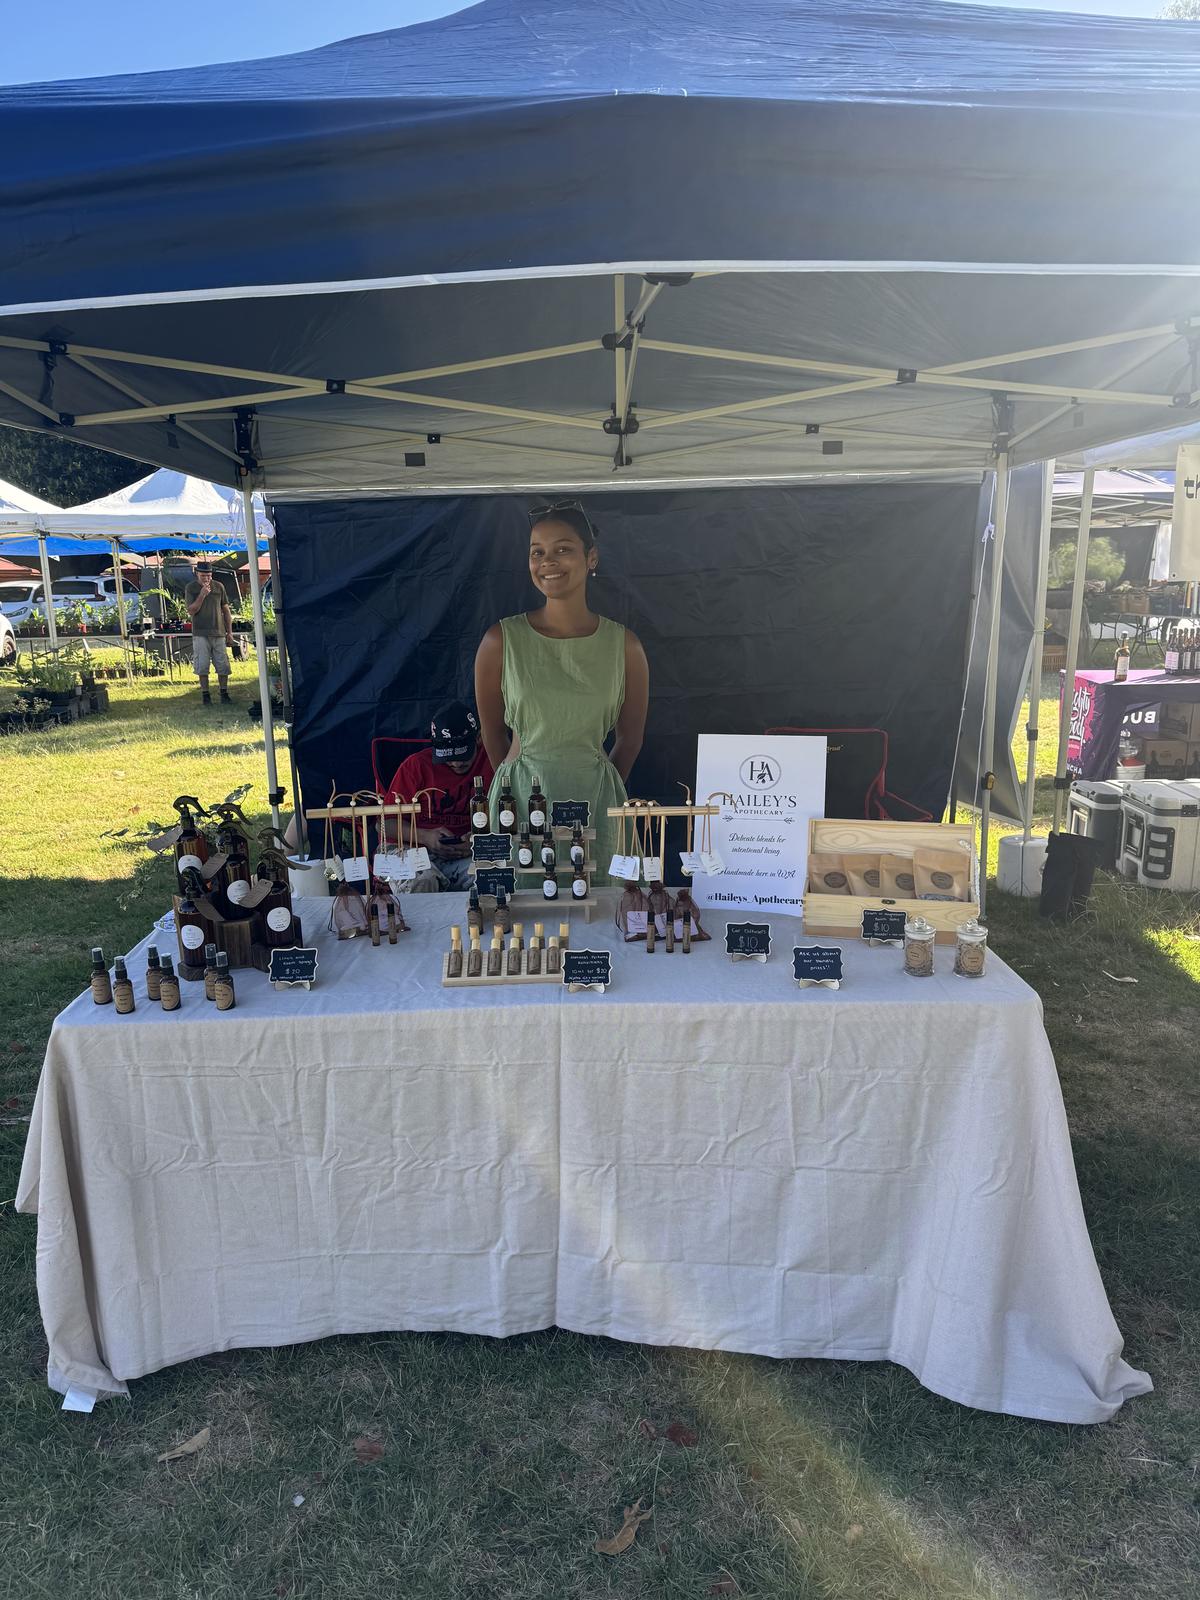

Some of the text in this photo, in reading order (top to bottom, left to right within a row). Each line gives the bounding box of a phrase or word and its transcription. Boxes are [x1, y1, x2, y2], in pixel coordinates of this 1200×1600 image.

[722, 794, 797, 808] HAILEY'S
[728, 833, 787, 844] Delicate blends for
[731, 847, 782, 857] intentional living
[717, 866, 754, 877] Handmade
[755, 867, 769, 877] here
[706, 892, 805, 908] @Haileys_Apothecary
[738, 935, 759, 949] $10
